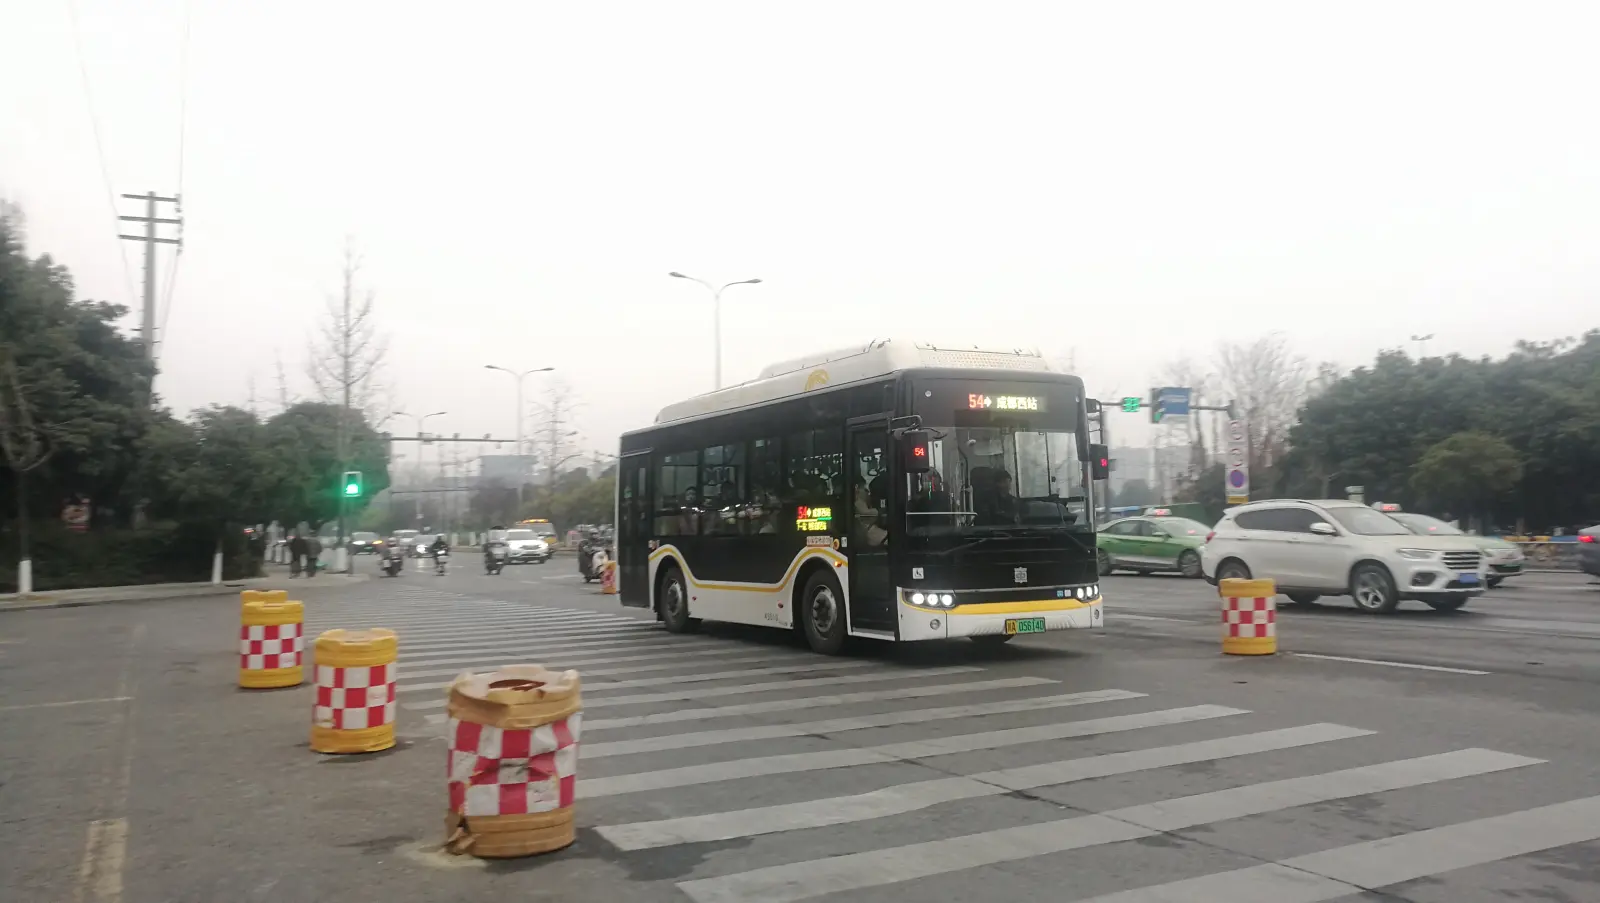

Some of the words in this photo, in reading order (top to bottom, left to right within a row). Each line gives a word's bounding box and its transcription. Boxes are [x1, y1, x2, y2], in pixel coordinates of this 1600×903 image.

[968, 393, 984, 409] 54
[996, 396, 1038, 410] 成都西站
[914, 447, 924, 456] 54
[797, 506, 807, 519] 54
